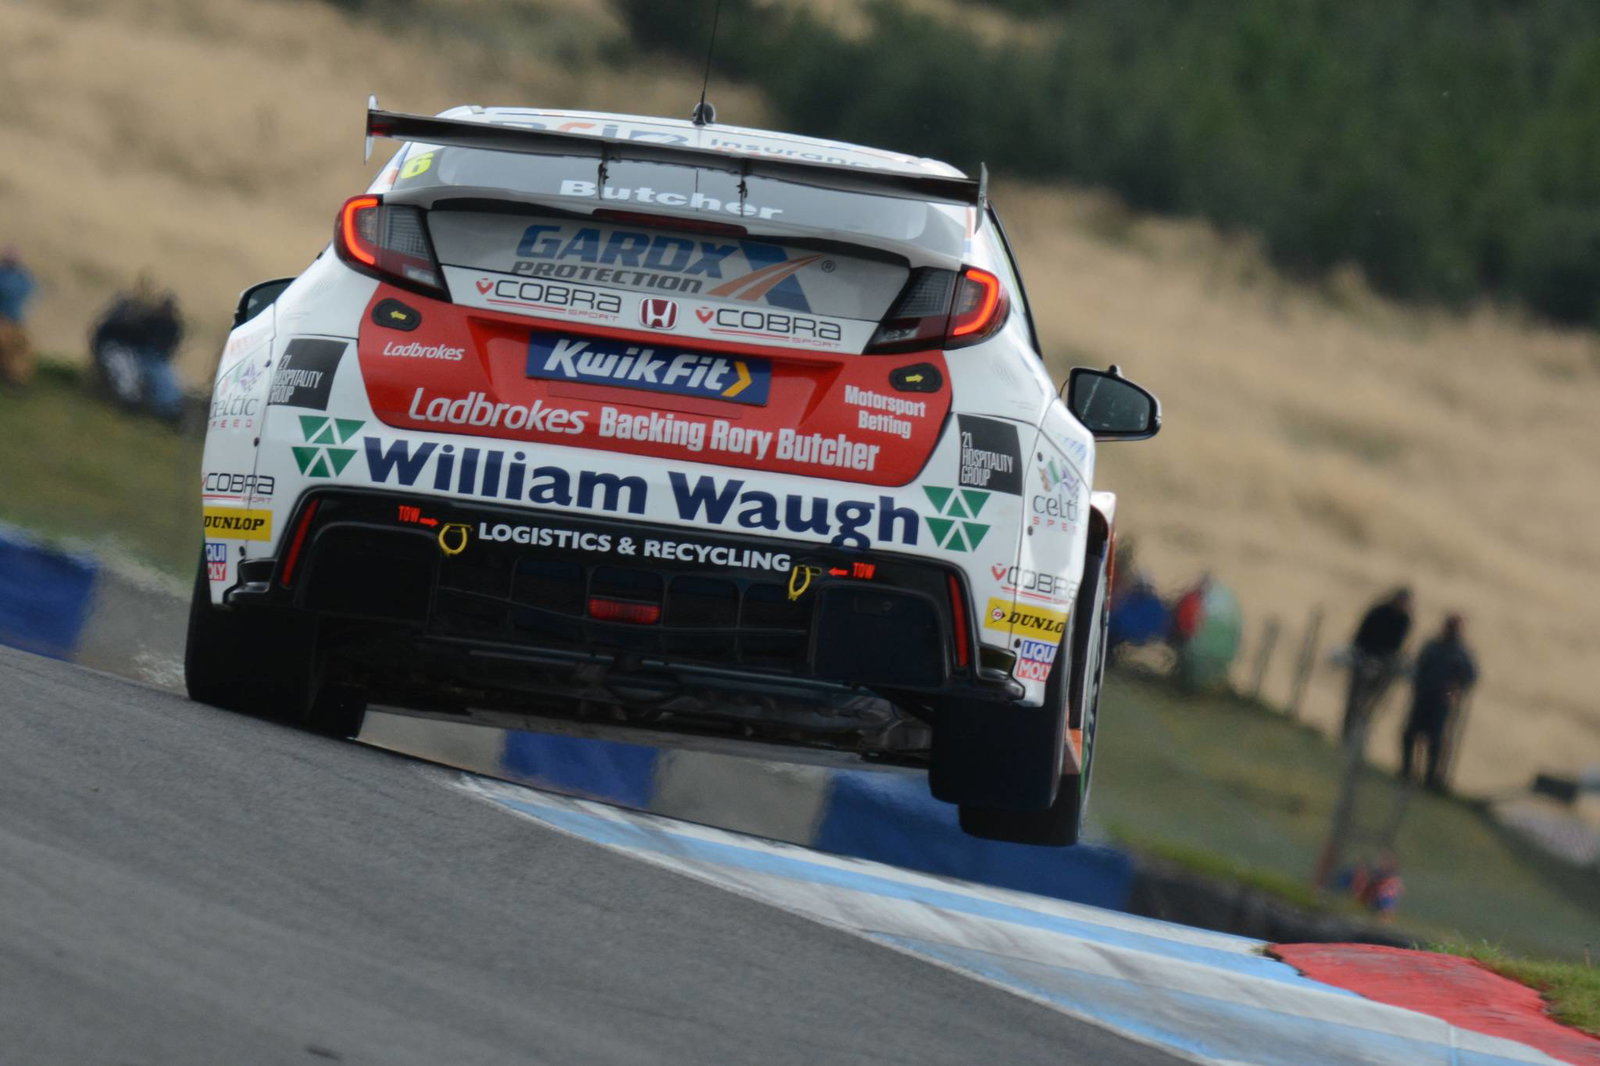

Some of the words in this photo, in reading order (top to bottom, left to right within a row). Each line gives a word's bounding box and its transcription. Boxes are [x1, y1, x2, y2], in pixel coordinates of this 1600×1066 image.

[401, 152, 434, 179] 6
[559, 179, 783, 219] Butcher
[516, 224, 741, 279] GARDX
[383, 341, 465, 361] Ladbrokes
[844, 384, 926, 417] Motorsport
[408, 387, 589, 435] Ladbrokes
[599, 406, 706, 451] Backing
[709, 420, 774, 461] Rory
[775, 428, 880, 471] Butcher
[858, 410, 912, 439] Betting
[961, 431, 973, 448] 21
[962, 447, 1013, 473] HOSPITALITY
[961, 465, 991, 486] GROUP
[363, 436, 648, 515] William
[668, 471, 920, 551] Waugh
[398, 504, 421, 523] TOW
[478, 522, 612, 552] LOGISTICS
[617, 536, 636, 556] &
[644, 539, 791, 573] RECYCLING
[852, 562, 876, 580] TOW
[1007, 611, 1065, 633] DUNLO
